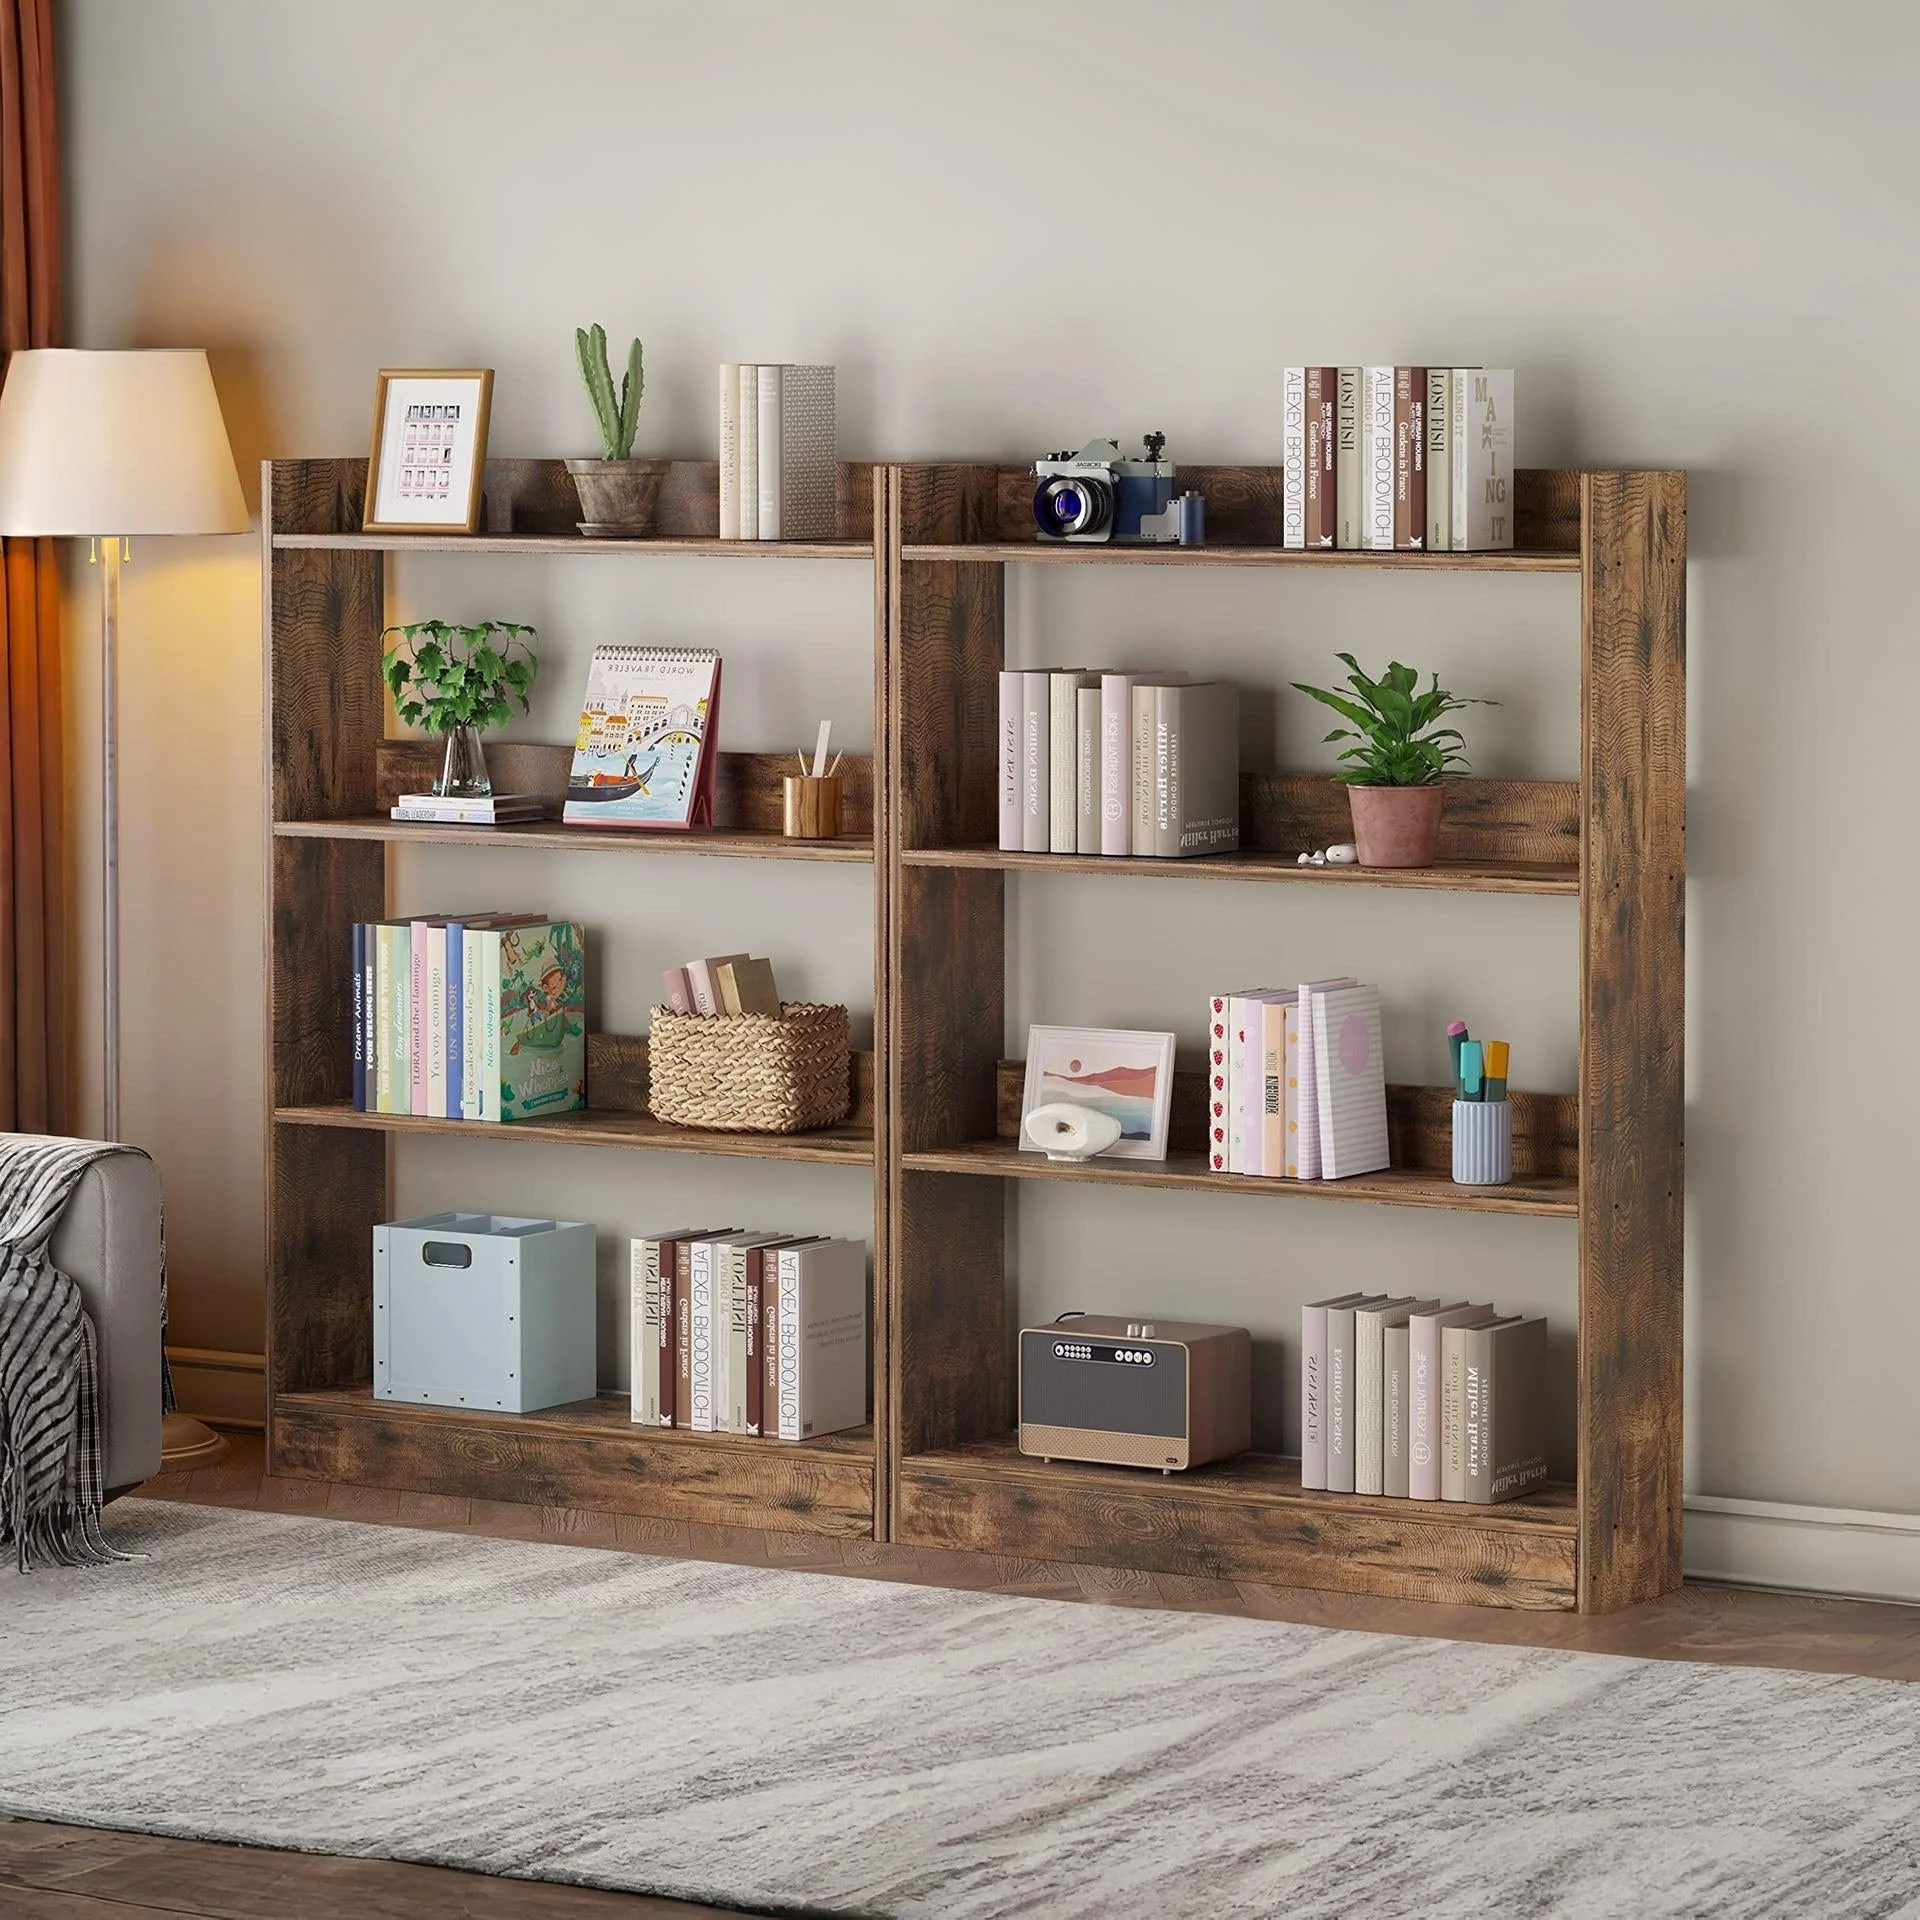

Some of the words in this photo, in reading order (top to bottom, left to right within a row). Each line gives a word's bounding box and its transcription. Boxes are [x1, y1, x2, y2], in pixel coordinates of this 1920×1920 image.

[1286, 371, 1302, 432] ALEXEY
[1340, 372, 1354, 414] LOST
[1375, 371, 1391, 432] ALEXEY
[1430, 374, 1444, 414] LOST
[1454, 377, 1464, 421] MAKING
[1309, 421, 1318, 458] Gardens
[1340, 416, 1354, 451] FISH
[1398, 422, 1408, 458] Gardens
[1430, 418, 1444, 452] FISH
[1454, 424, 1464, 436] IT
[1309, 460, 1318, 468] in
[1398, 460, 1408, 468] in
[1286, 436, 1302, 536] BRODOVITCH
[1309, 469, 1318, 500] France
[1375, 436, 1391, 537] BRODOVITCH
[1398, 470, 1408, 501] France
[354, 973, 362, 1019] Animals
[393, 982, 404, 1033] dreamers
[431, 967, 441, 1027] conmigo
[449, 983, 457, 1032] AMOR
[465, 998, 474, 1014] de
[486, 986, 494, 1038] Whopper
[354, 1022, 362, 1060] Dream
[431, 1032, 441, 1056] voy
[449, 1038, 457, 1060] UN
[486, 1042, 494, 1068] Nico
[431, 1061, 441, 1080] Yo
[530, 1058, 558, 1077] Nico
[1266, 1050, 1277, 1070] BOOK
